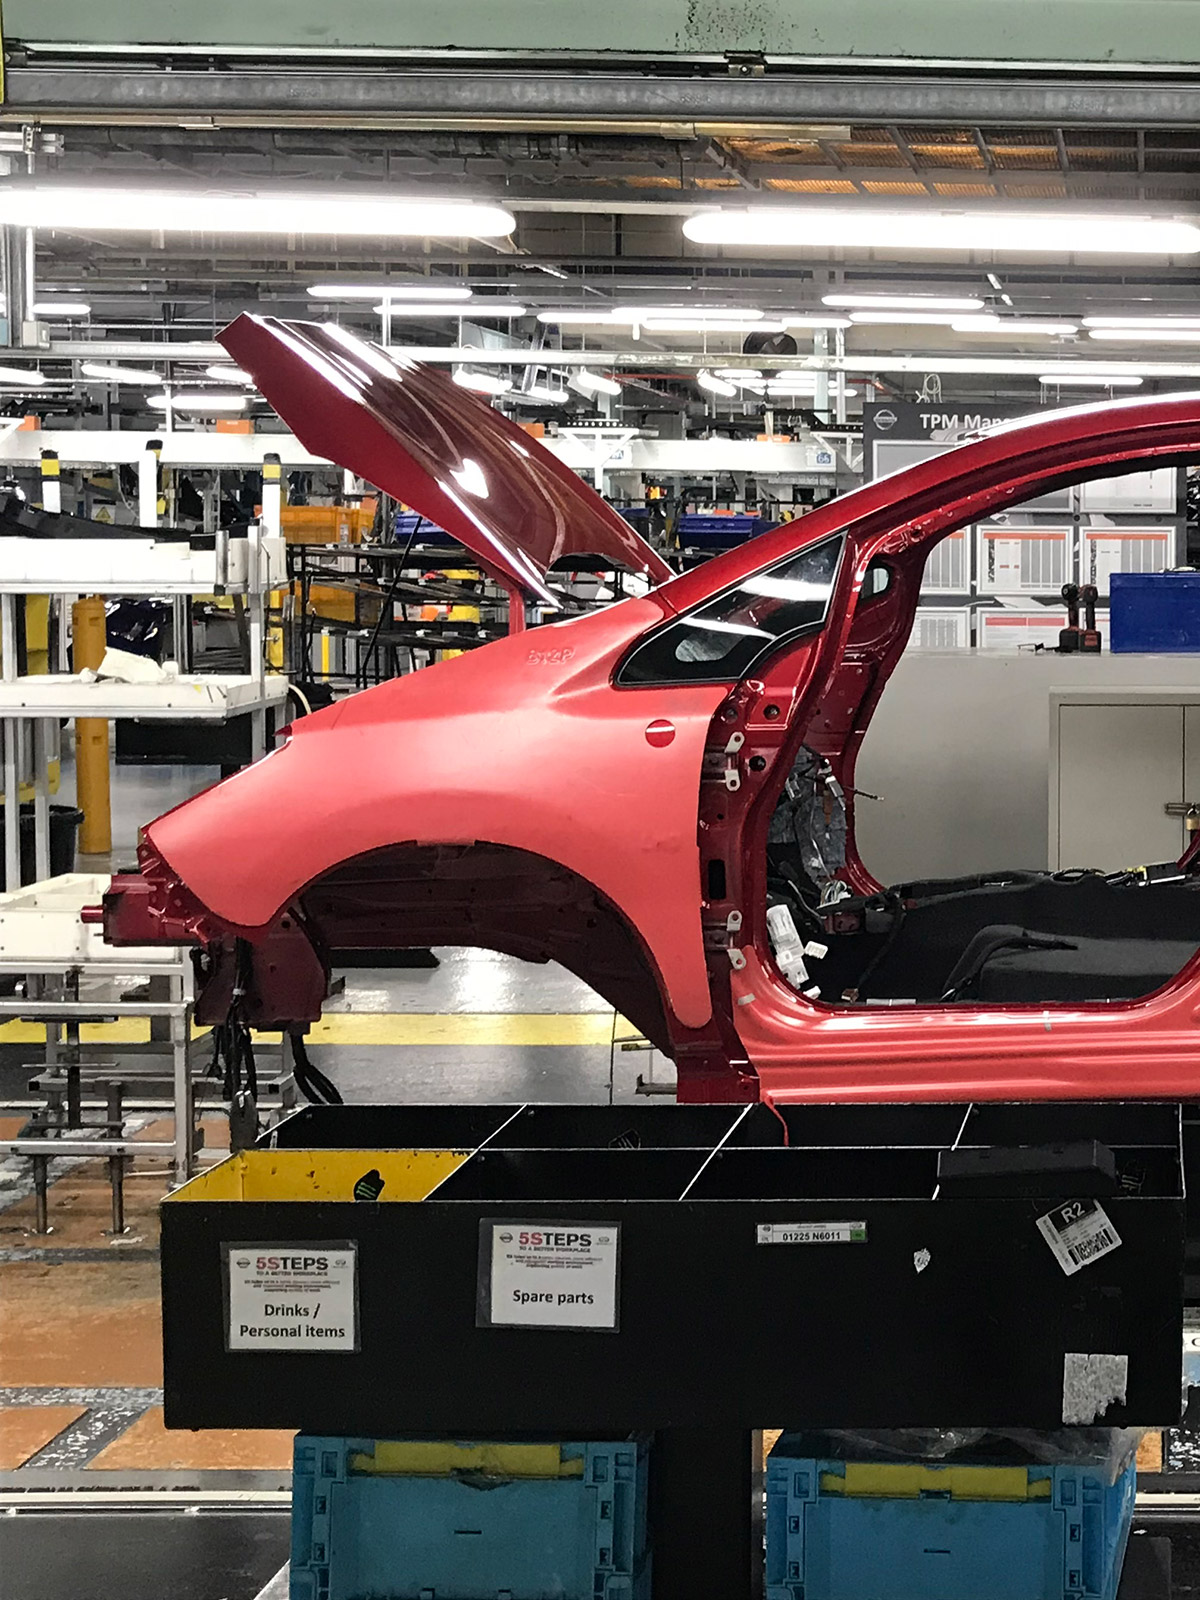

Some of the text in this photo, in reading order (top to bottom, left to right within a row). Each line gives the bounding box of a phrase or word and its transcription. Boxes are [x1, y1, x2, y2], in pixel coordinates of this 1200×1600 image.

[919, 413, 958, 429] TPM
[1060, 1201, 1086, 1224] R2
[519, 1231, 592, 1247] 5STEPS
[782, 1231, 841, 1241] 01225 N6011
[256, 1256, 329, 1271] 5STEPS
[512, 1289, 595, 1306] Spare parts
[264, 1302, 321, 1319] Drinks /
[240, 1324, 346, 1338] Personal items
